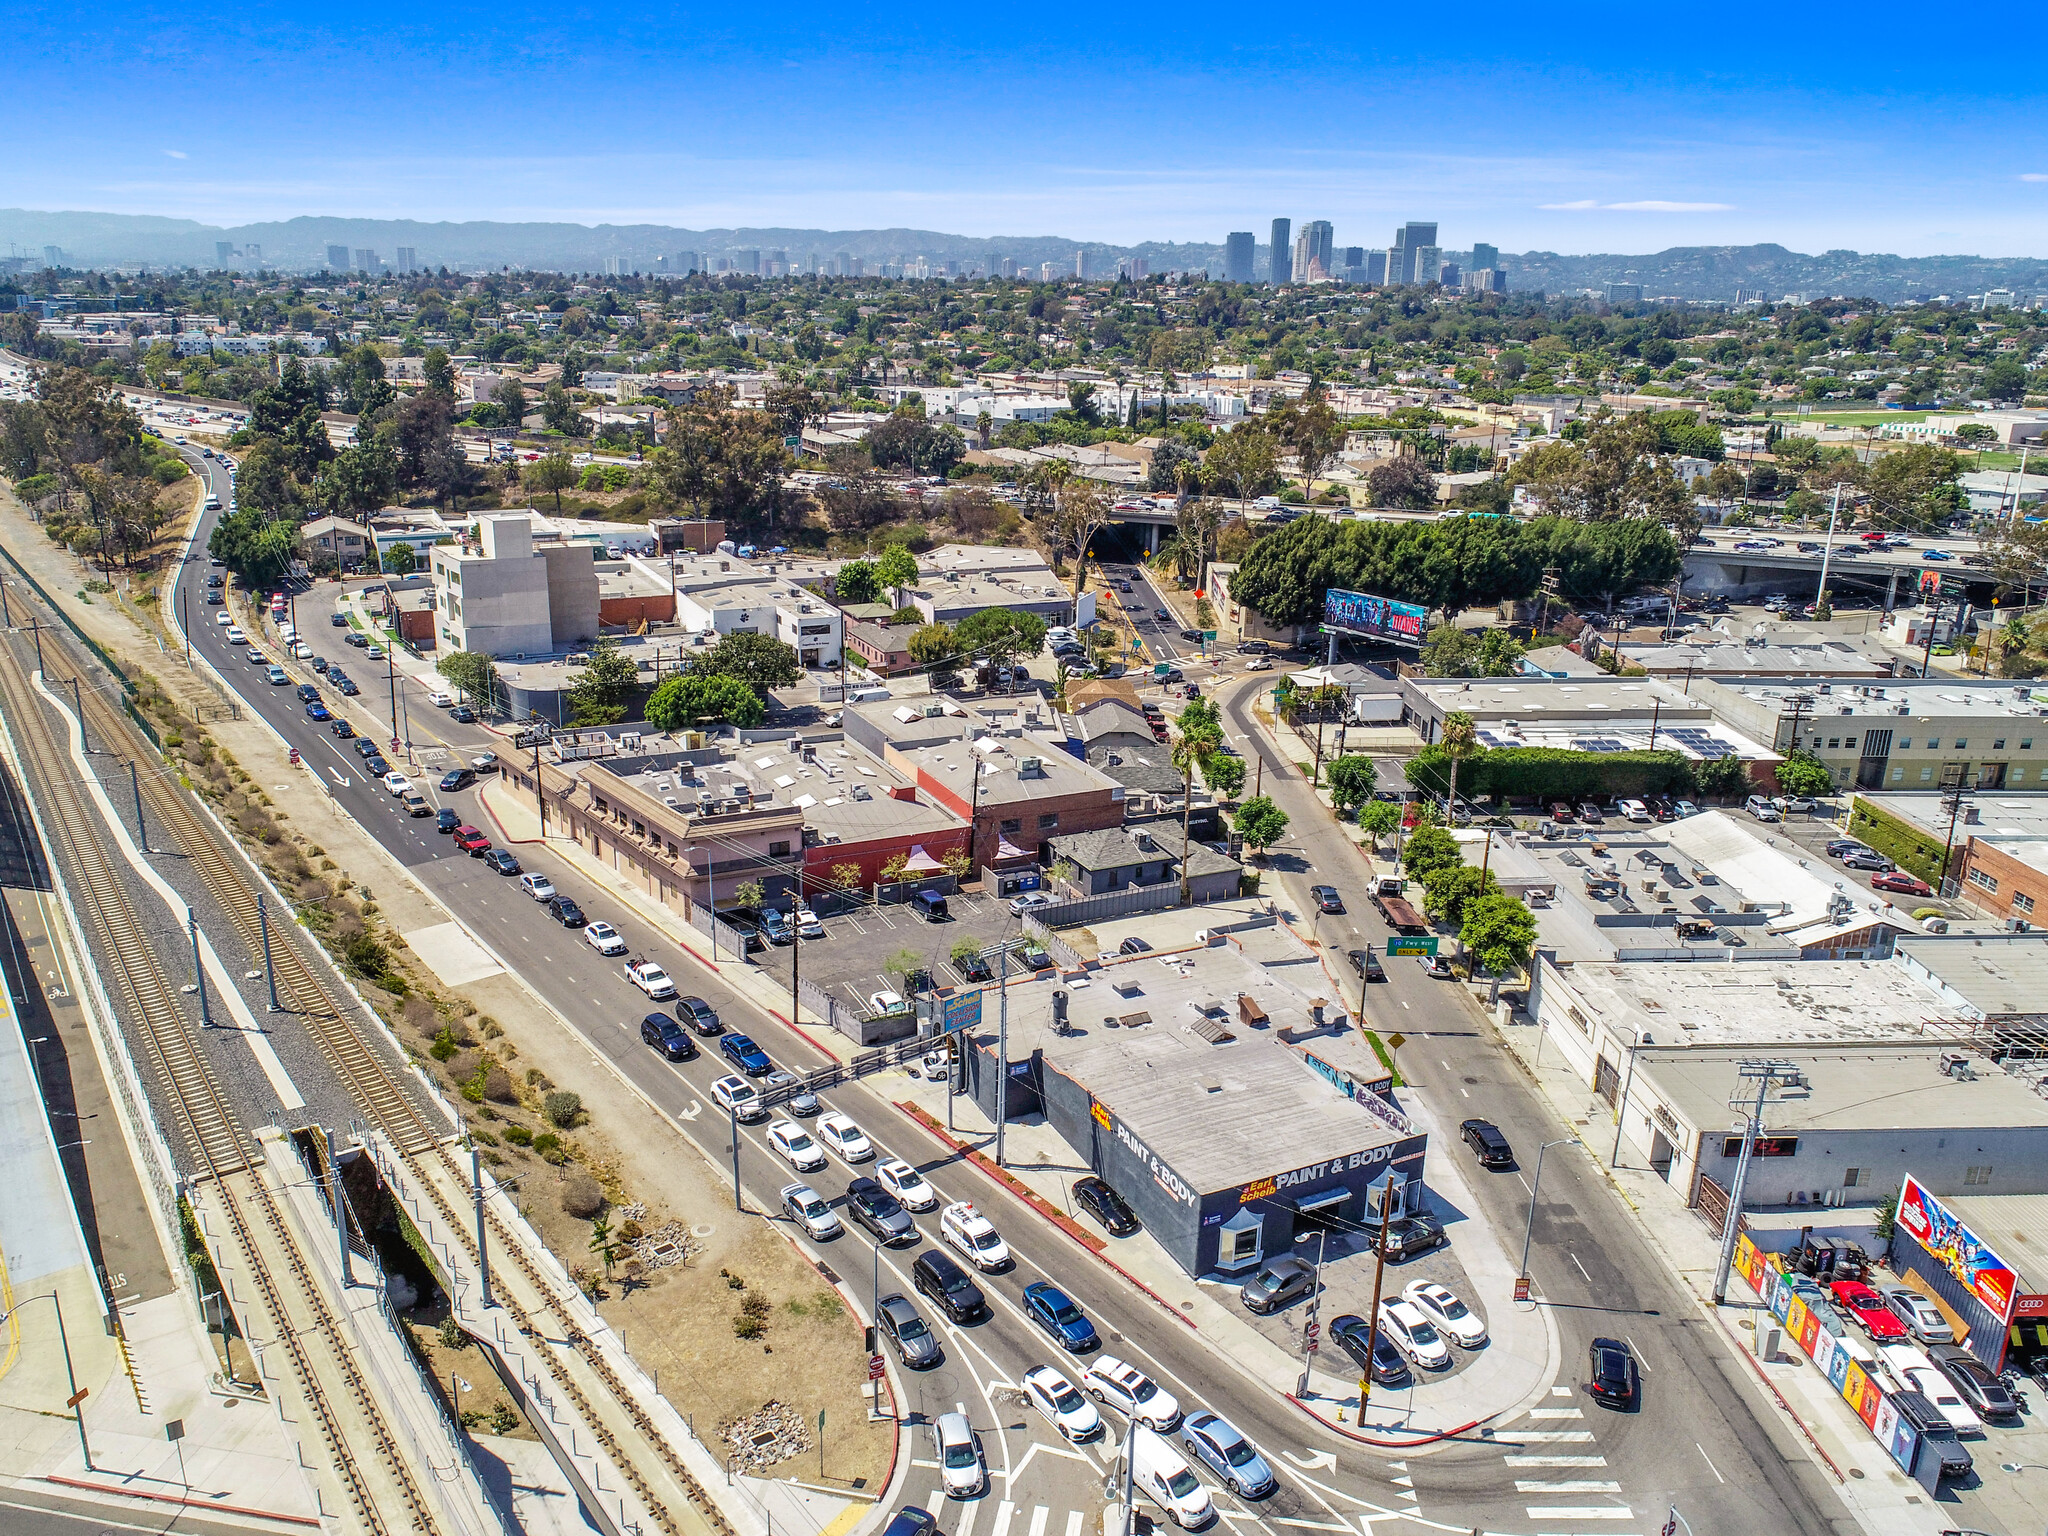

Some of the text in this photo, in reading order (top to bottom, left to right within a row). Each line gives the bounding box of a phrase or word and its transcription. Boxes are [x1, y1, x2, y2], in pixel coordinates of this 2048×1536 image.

[426, 752, 447, 760] STOP
[947, 991, 981, 1012] Scheib
[946, 1002, 980, 1020] COLLISION
[950, 1012, 976, 1026] CENTER
[1374, 1079, 1391, 1091] BODY
[1090, 1107, 1111, 1131] Scheib
[1095, 1103, 1110, 1120] Earl
[1117, 1123, 1149, 1163] PAINT
[1150, 1156, 1161, 1176] &
[1161, 1165, 1196, 1207] BODY
[1276, 1163, 1328, 1190] PAINT
[1331, 1158, 1343, 1174] &
[1349, 1143, 1397, 1170] BODY
[1250, 1177, 1272, 1192] Earl
[1239, 1186, 1277, 1204] Scheib
